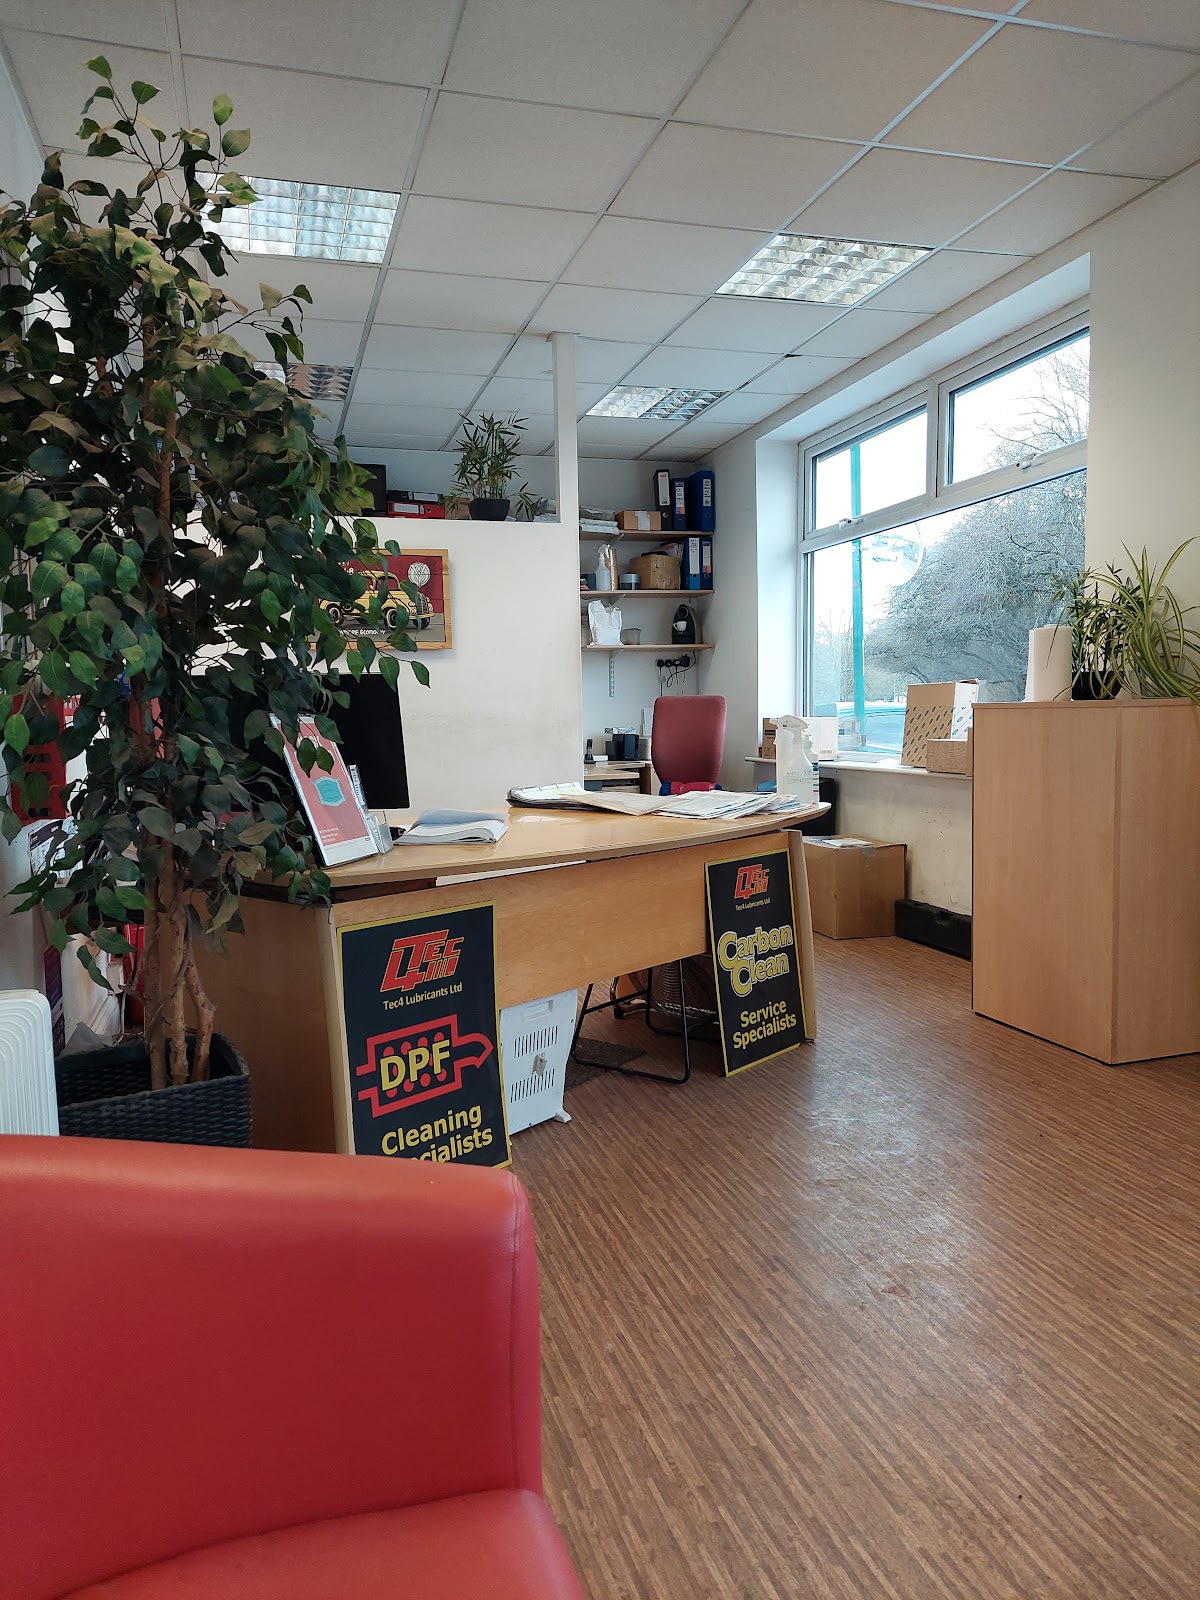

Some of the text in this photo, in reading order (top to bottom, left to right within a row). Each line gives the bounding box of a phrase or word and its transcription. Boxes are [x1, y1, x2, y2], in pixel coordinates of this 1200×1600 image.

[717, 924, 794, 972] Carbon
[730, 952, 790, 998] Clean
[383, 982, 463, 1010] Tec4 Lubricants Ltd
[740, 1000, 787, 1028] Service
[733, 1012, 797, 1049] Specialists
[379, 1039, 452, 1091] DPF
[381, 1105, 482, 1155] Cleaning
[411, 1128, 493, 1162] cialists
